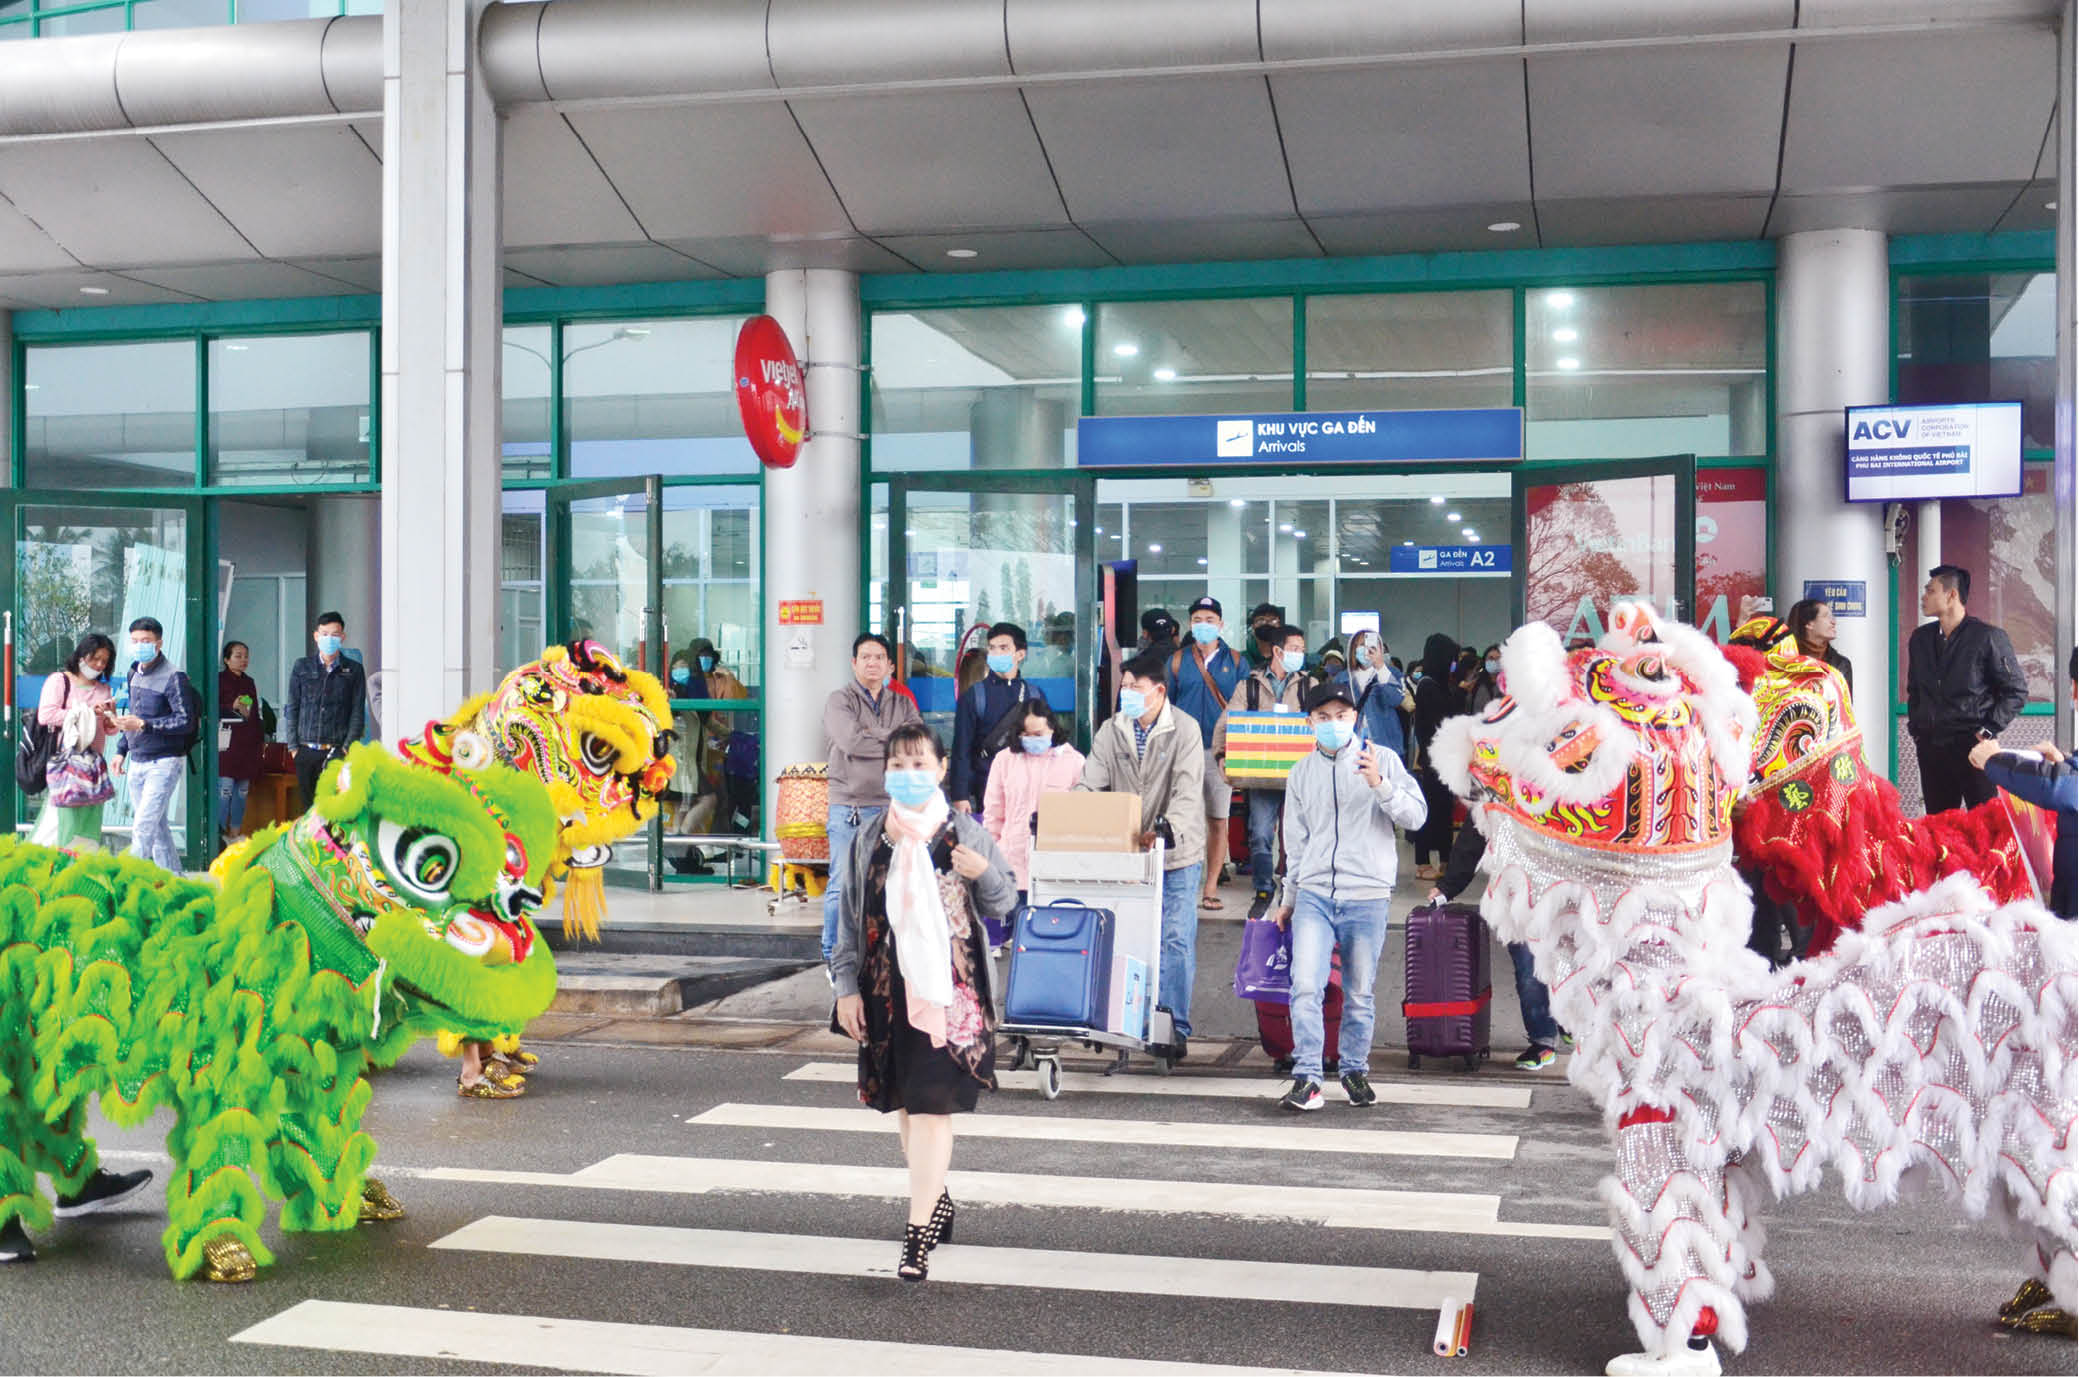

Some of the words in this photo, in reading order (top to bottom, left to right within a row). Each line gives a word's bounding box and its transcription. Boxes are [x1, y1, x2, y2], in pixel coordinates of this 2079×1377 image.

[1257, 423, 1285, 436] KHU
[1288, 421, 1319, 438] VỰC
[1321, 421, 1345, 435] GA
[1347, 414, 1376, 434] ĐẾN
[1853, 419, 1912, 441] ACV
[1258, 440, 1306, 453] Arrivals
[1883, 460, 1934, 468] INTERNATIONAL
[1935, 459, 1963, 467] AIRPORT
[1714, 481, 1737, 491] Nam
[1440, 551, 1451, 559] GA
[1470, 551, 1495, 567] A2
[1563, 594, 1732, 648] AM
